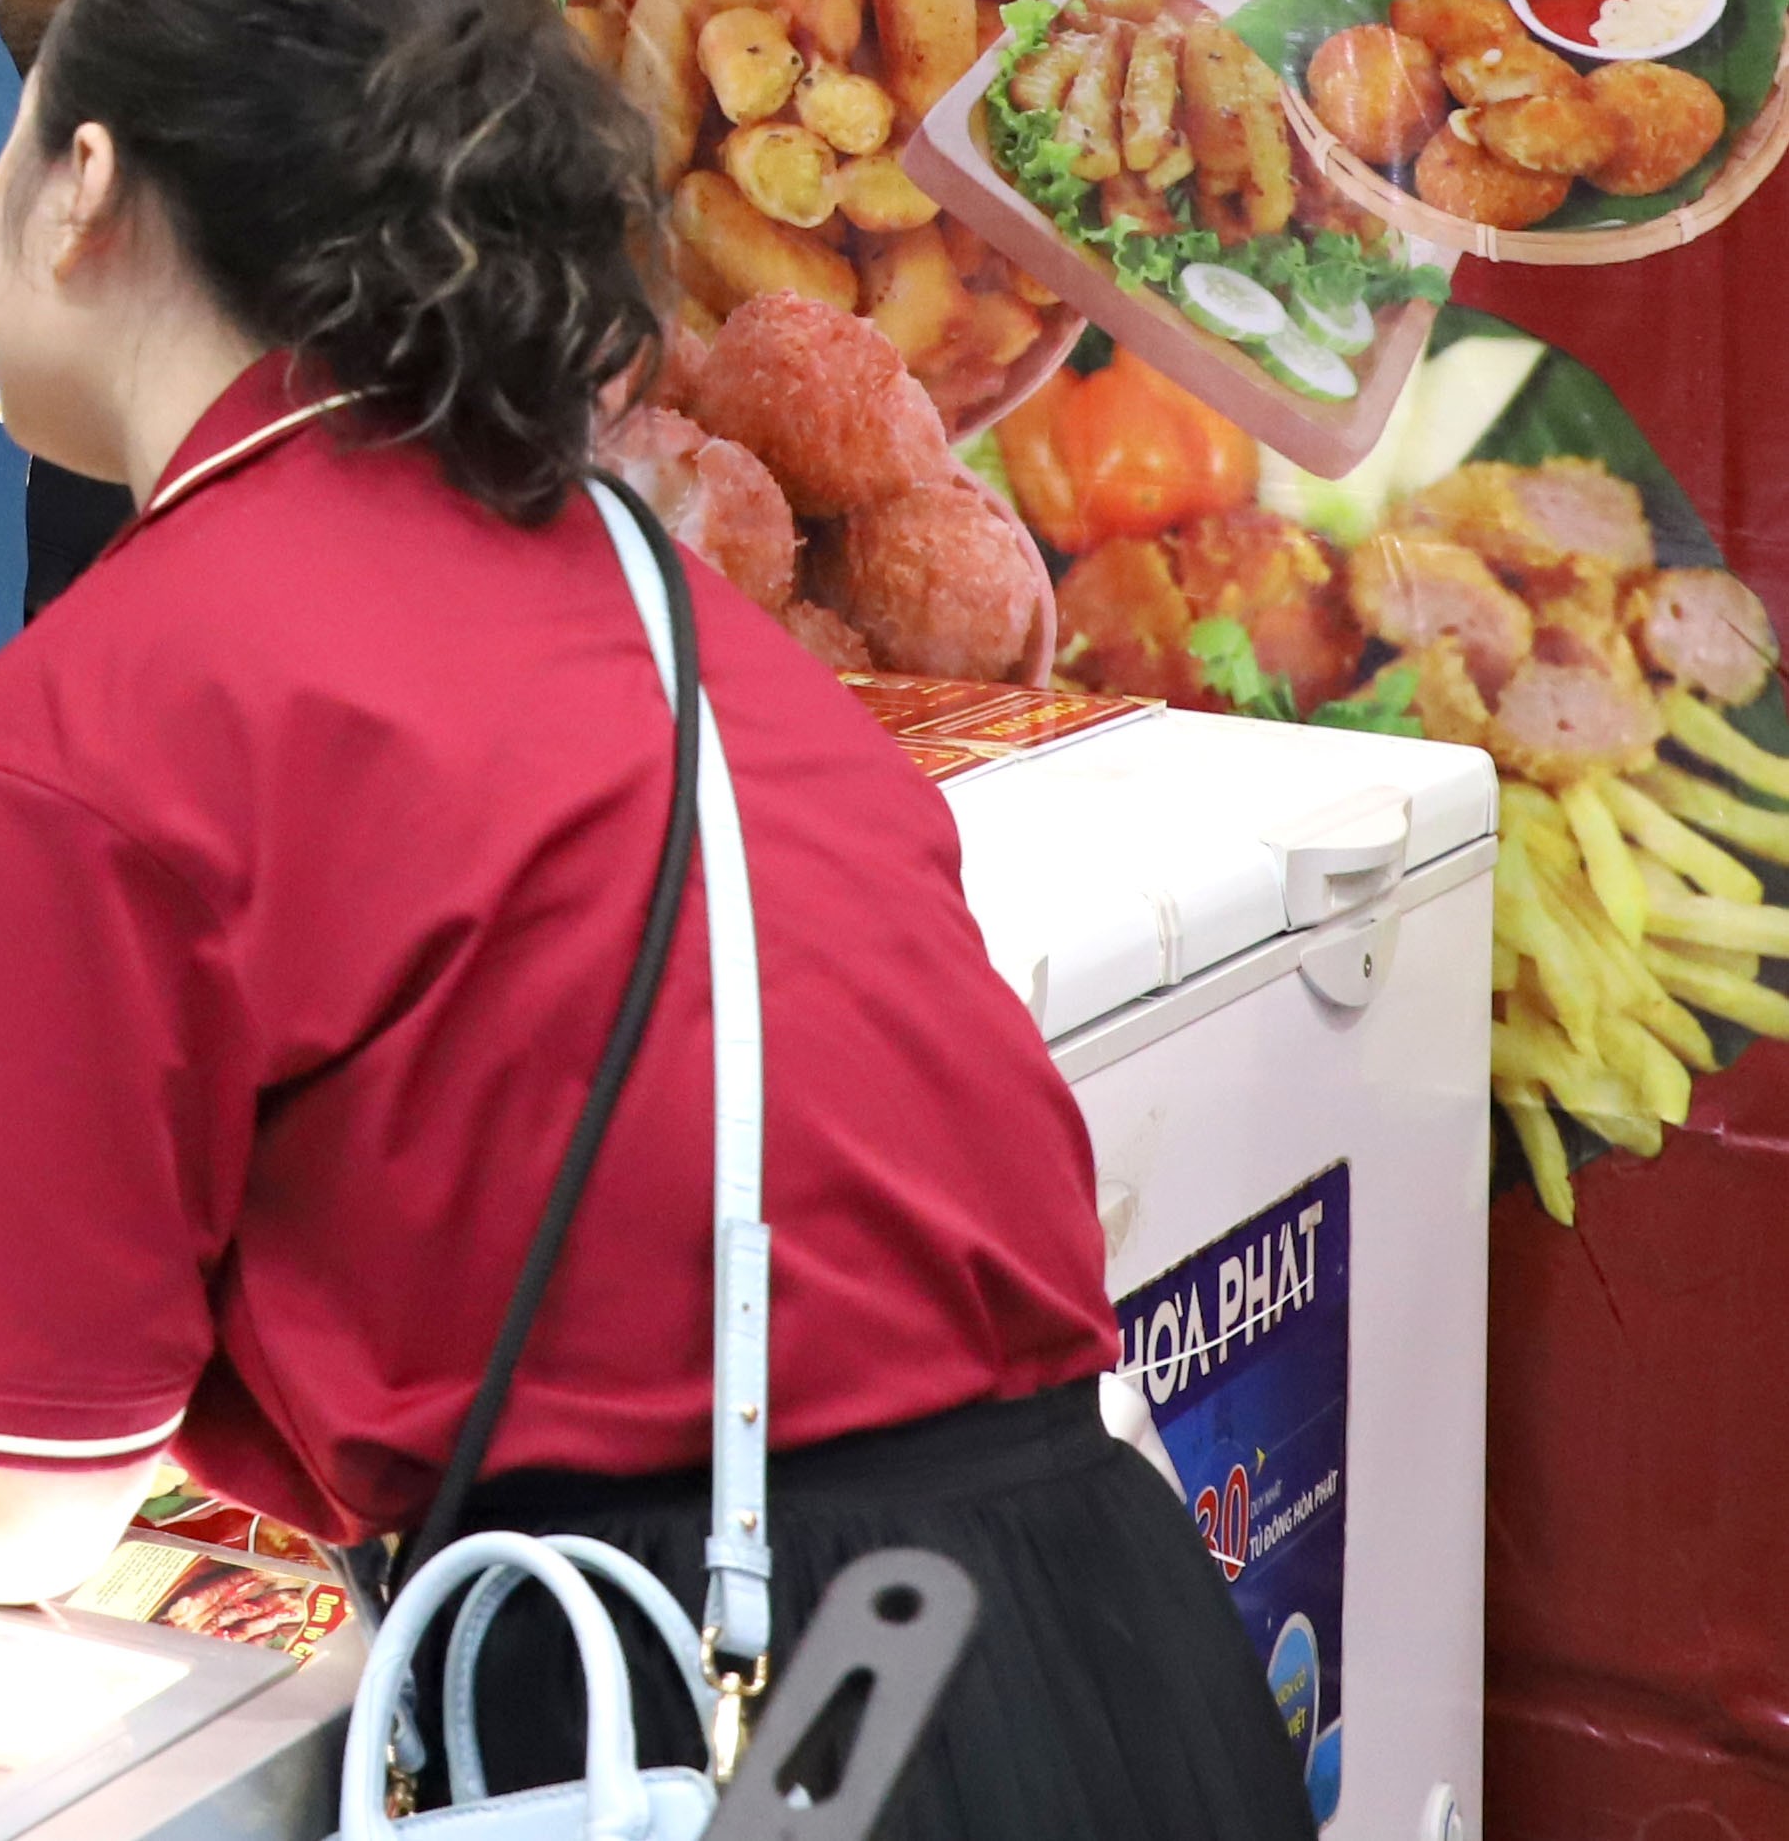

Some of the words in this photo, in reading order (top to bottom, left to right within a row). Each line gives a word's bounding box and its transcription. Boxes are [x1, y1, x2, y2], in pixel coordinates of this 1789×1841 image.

[1219, 1200, 1323, 1365] PHÁT
[1293, 1490, 1314, 1526] HÒA
[1314, 1469, 1339, 1509] PHÁT
